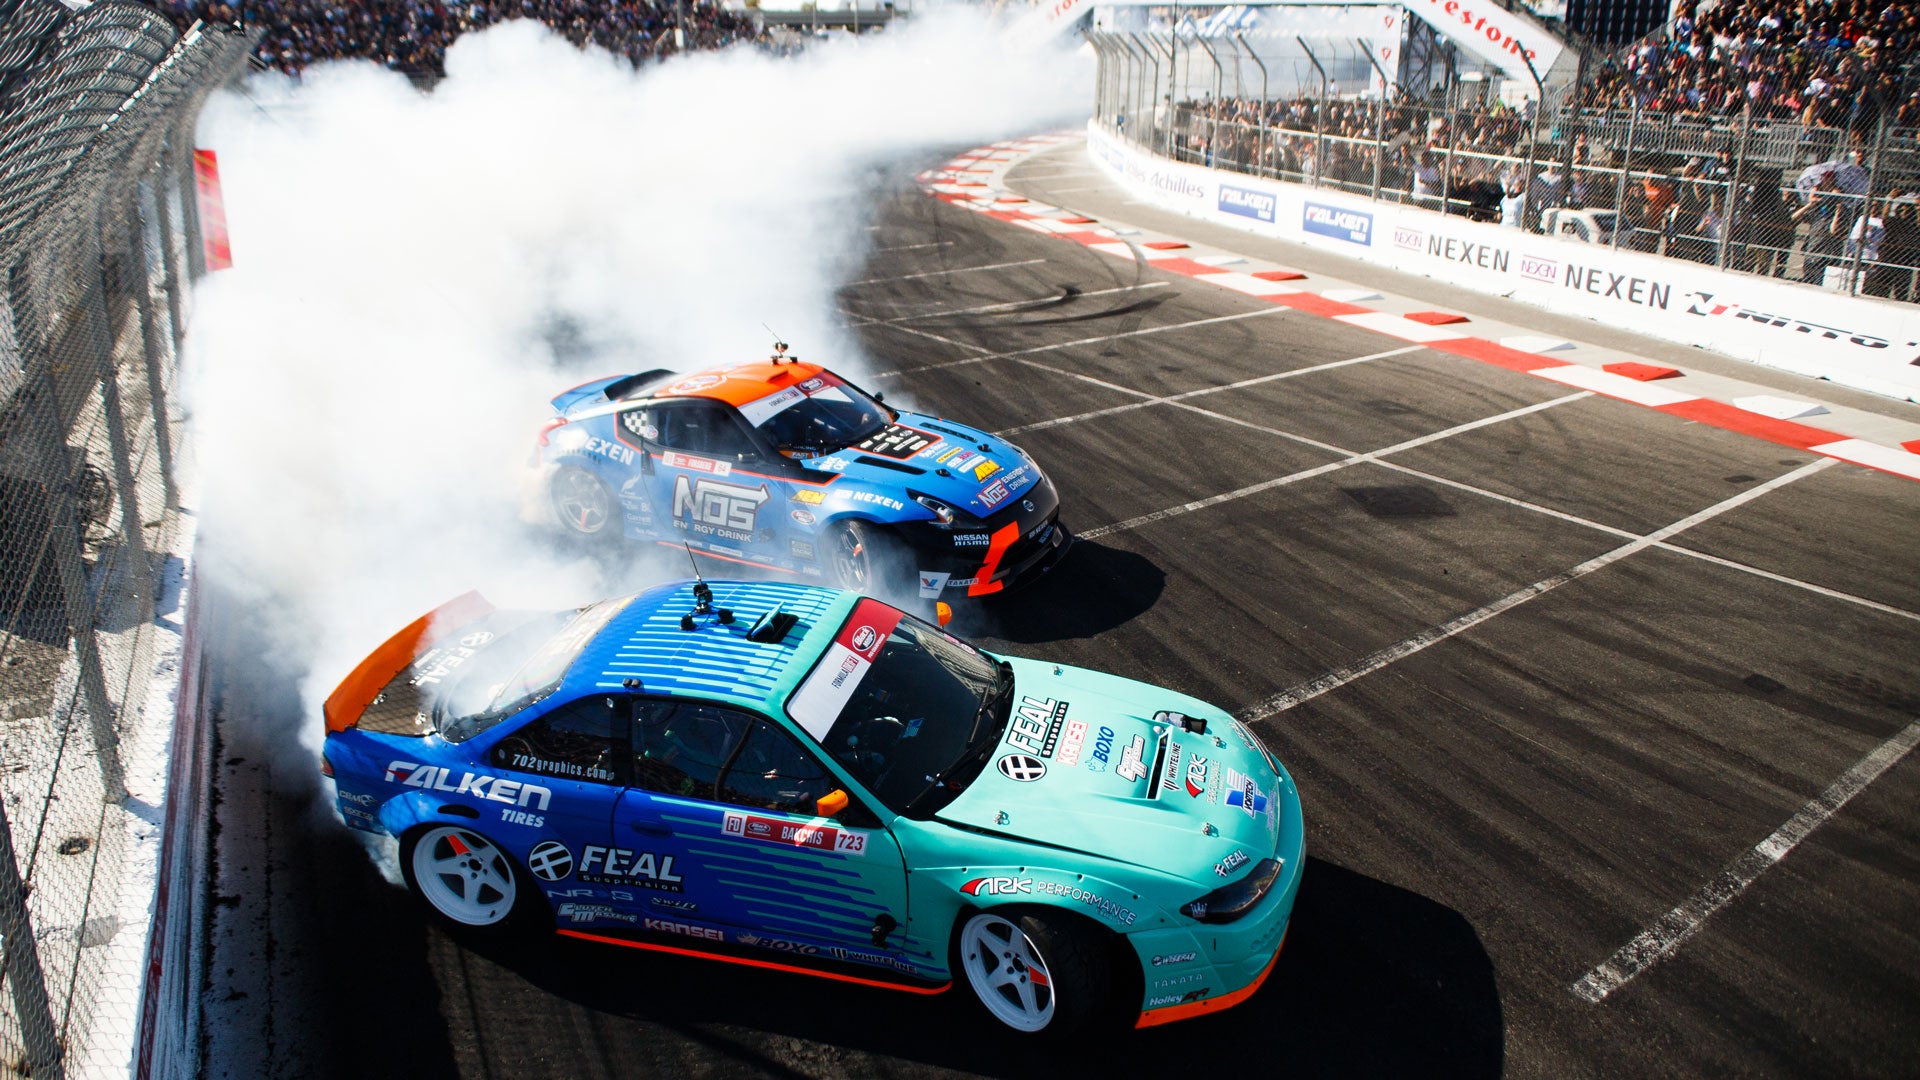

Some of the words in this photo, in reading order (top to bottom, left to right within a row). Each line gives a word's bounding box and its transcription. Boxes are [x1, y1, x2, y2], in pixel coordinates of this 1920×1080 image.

[1221, 188, 1274, 211] FALKEN
[1306, 205, 1370, 233] FALKEN
[1428, 234, 1510, 273] NEXEN
[1565, 264, 1672, 310] NEXEN
[584, 436, 634, 466] EXEN
[976, 478, 1012, 510] NOS
[1008, 476, 1031, 492] DRINK
[672, 474, 771, 533] NOS
[853, 491, 904, 511] NEXEN
[673, 519, 715, 535] ENRGY
[717, 527, 752, 542] DRINK
[953, 534, 990, 542] NISSAN
[832, 668, 849, 689] FORMULA
[1006, 695, 1058, 757] FEAL
[1042, 702, 1069, 757] Suspension
[1093, 725, 1115, 764] BOXO
[512, 754, 608, 780] 702graphics.com
[1168, 742, 1181, 779] WHITELINE
[384, 760, 551, 811] FALKEN
[501, 808, 545, 828] TIRES
[727, 817, 741, 832] FD
[781, 825, 823, 845] BAKCHIS
[838, 833, 864, 851] 723
[579, 845, 682, 883] FEAL
[1223, 849, 1247, 870] FEAL
[582, 874, 680, 892] Suspension
[1037, 881, 1137, 925] PERFORMANCE
[644, 918, 725, 942] KANSEI
[756, 937, 820, 955] BOXO
[851, 951, 918, 974] WHITELINE
[1154, 973, 1203, 989] TAKATA
[1150, 994, 1183, 1006] Holley
